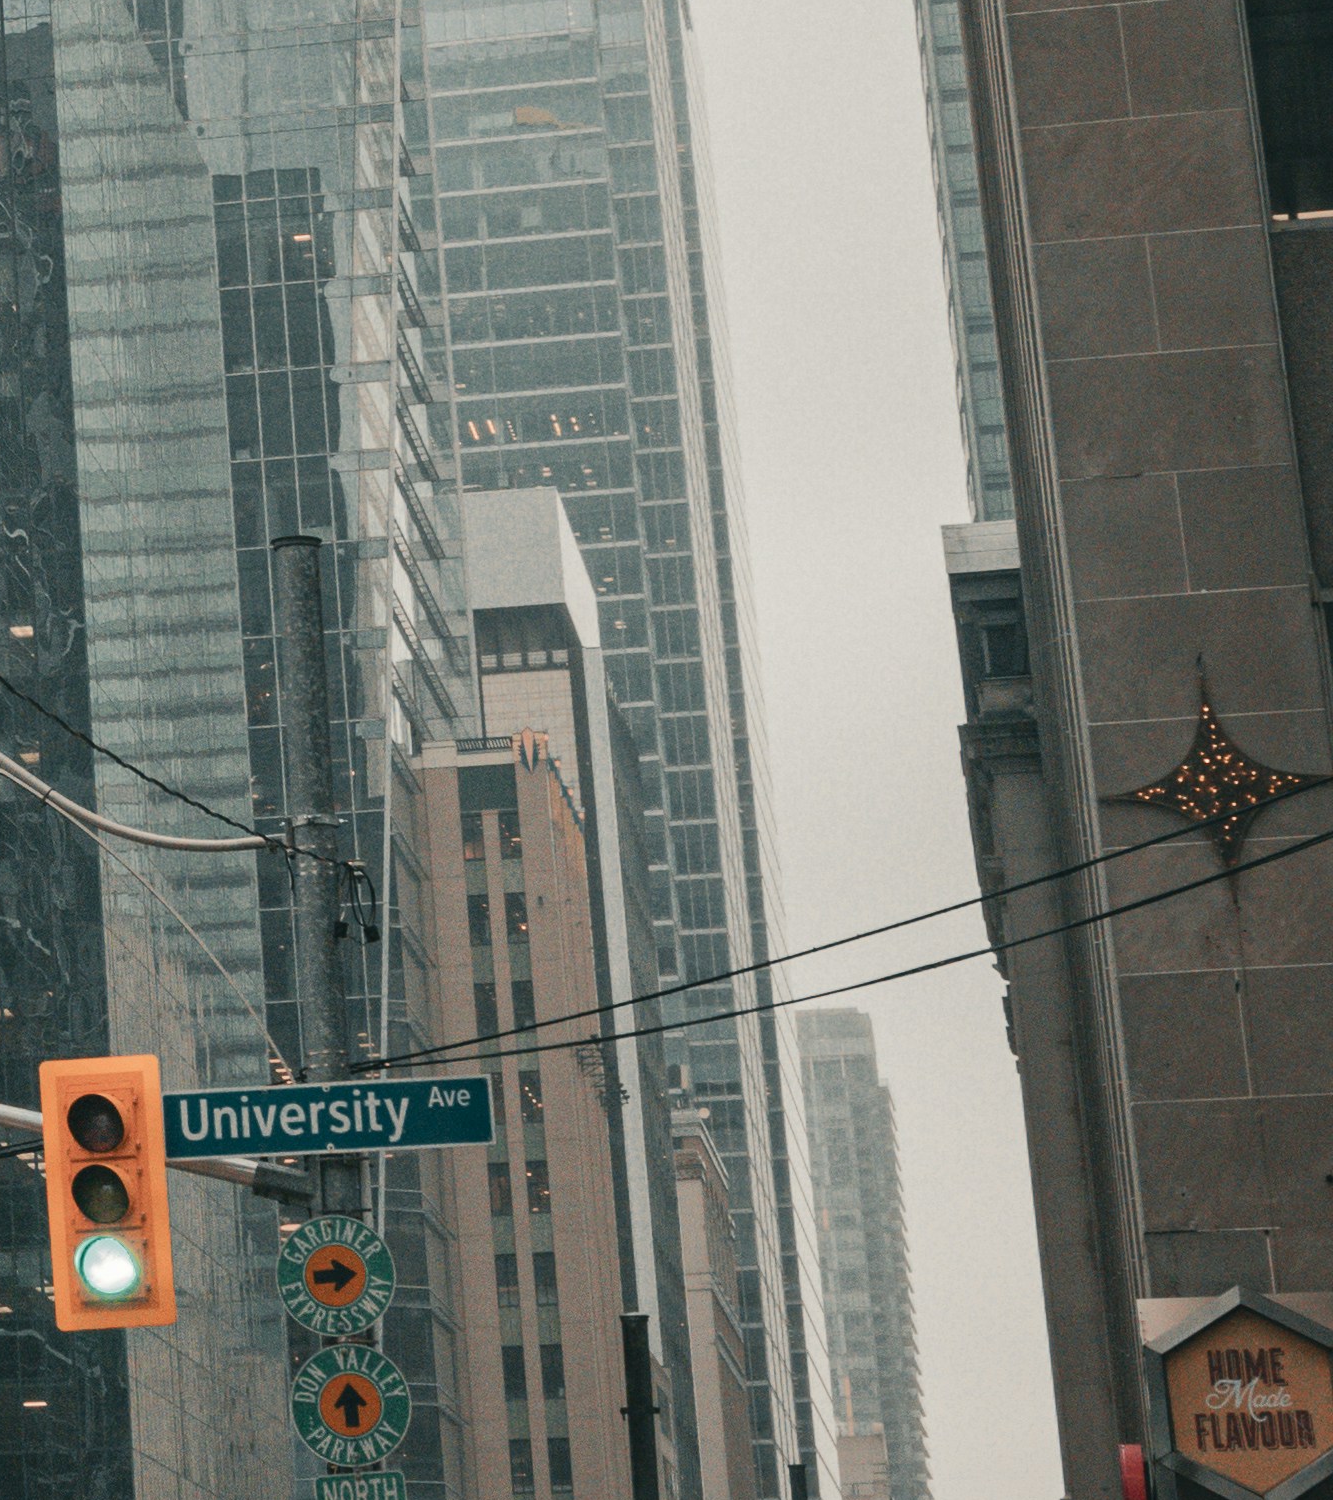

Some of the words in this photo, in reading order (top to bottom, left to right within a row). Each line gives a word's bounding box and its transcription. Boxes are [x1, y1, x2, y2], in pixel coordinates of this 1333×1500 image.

[180, 1088, 409, 1143] University
[428, 1085, 471, 1108] Ave
[283, 1219, 382, 1265] GARDINER
[281, 1274, 392, 1334] EXPRESSWAY
[293, 1362, 327, 1403] DON
[333, 1347, 407, 1398] VALLEY
[1206, 1347, 1288, 1388] HOME
[1205, 1376, 1294, 1423] Made
[307, 1420, 401, 1463] PARKWAY
[1193, 1409, 1317, 1451] FLAVOUR
